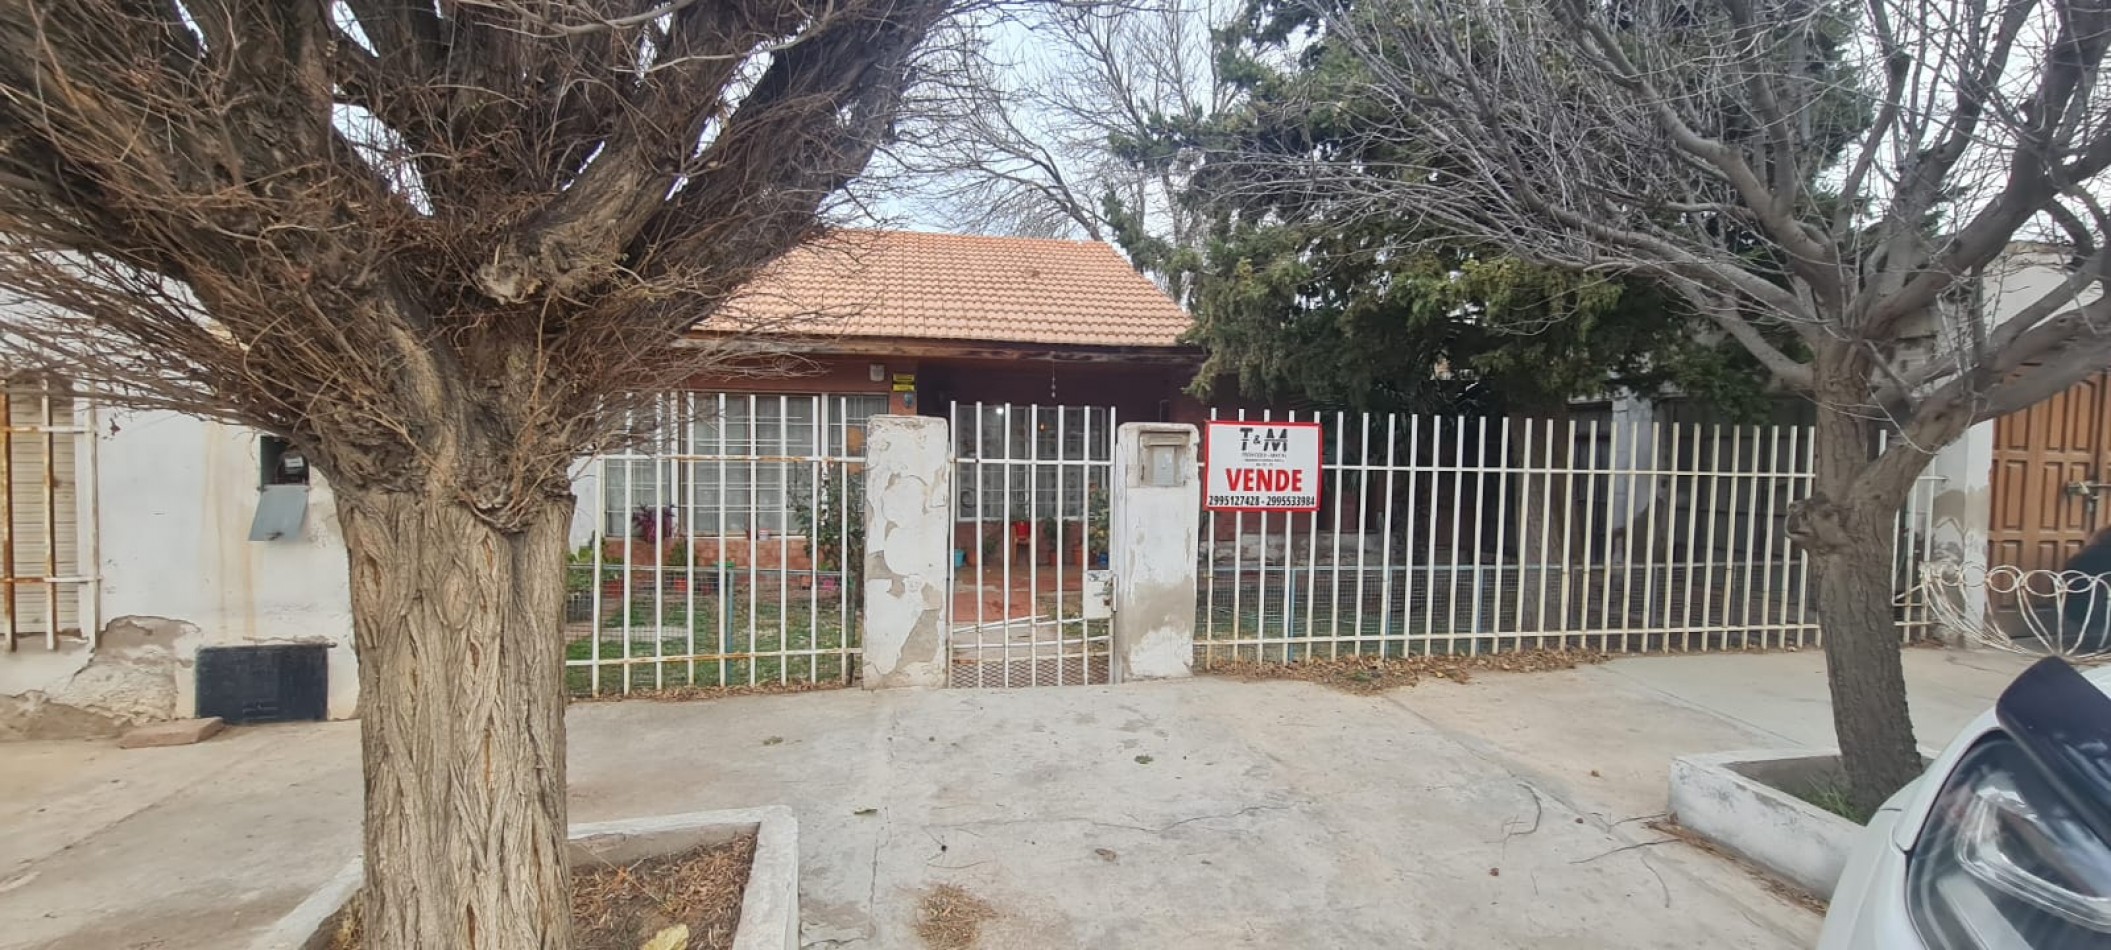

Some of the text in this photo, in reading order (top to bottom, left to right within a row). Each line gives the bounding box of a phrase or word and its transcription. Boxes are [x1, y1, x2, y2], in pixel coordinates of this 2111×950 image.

[1225, 468, 1303, 492] VENDE
[1209, 495, 1260, 506] 2995127428
[1266, 495, 1315, 506] 2995533984
